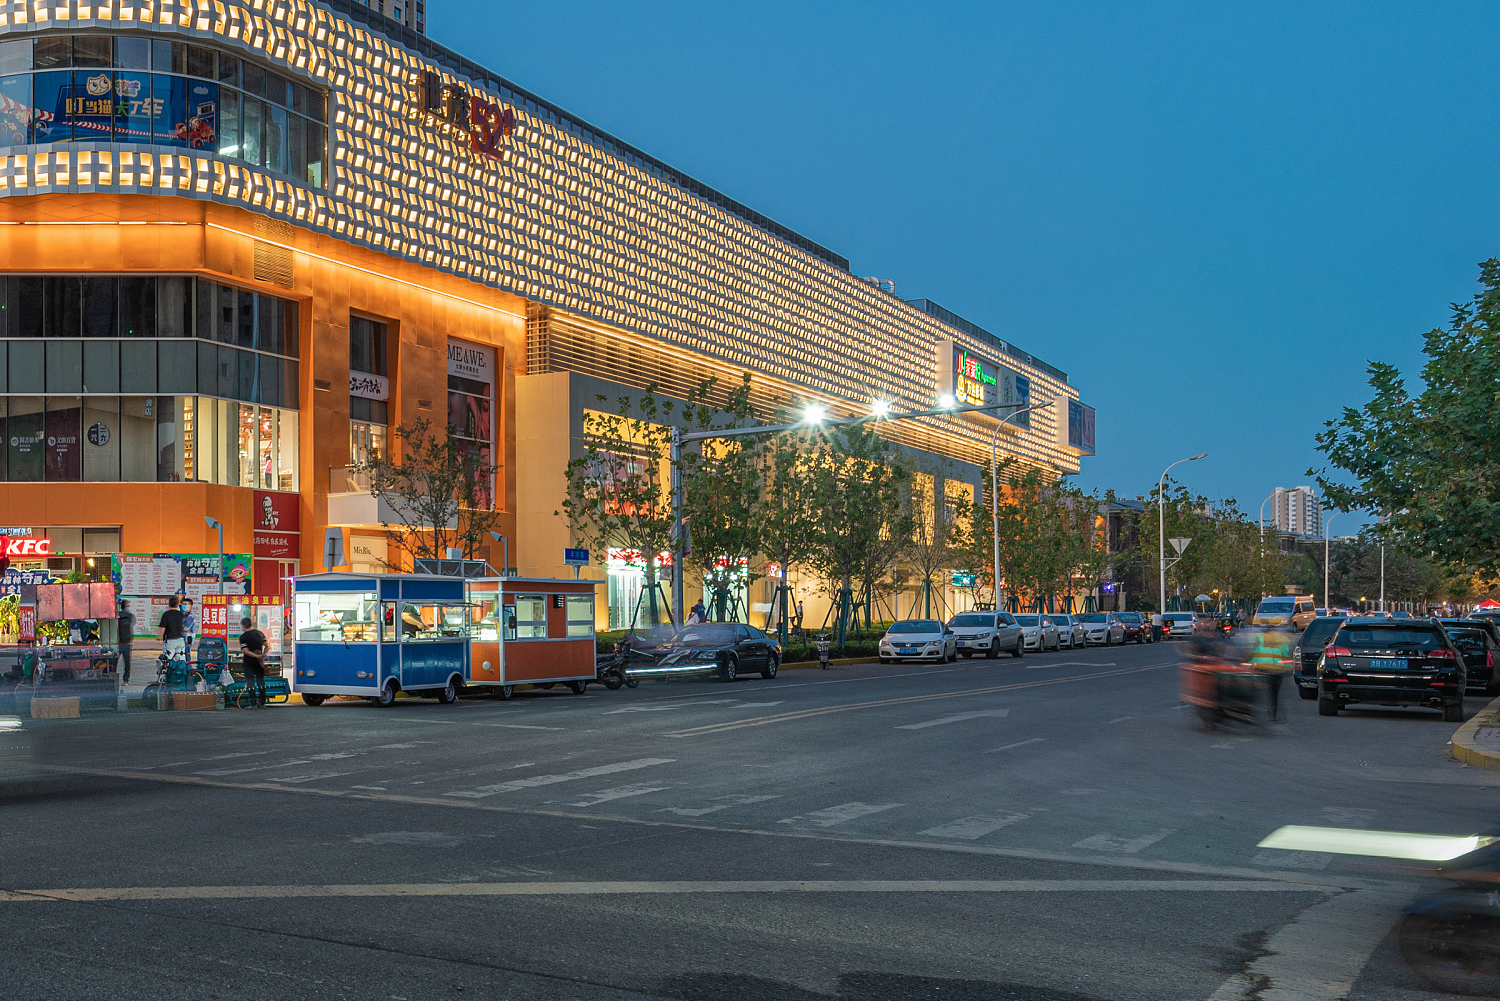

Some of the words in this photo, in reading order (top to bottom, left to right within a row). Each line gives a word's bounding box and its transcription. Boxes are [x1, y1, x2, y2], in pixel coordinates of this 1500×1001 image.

[5, 539, 50, 555] KFC
[231, 595, 280, 605] 茶油臭豆腐
[202, 607, 227, 625] 臭豆腐
